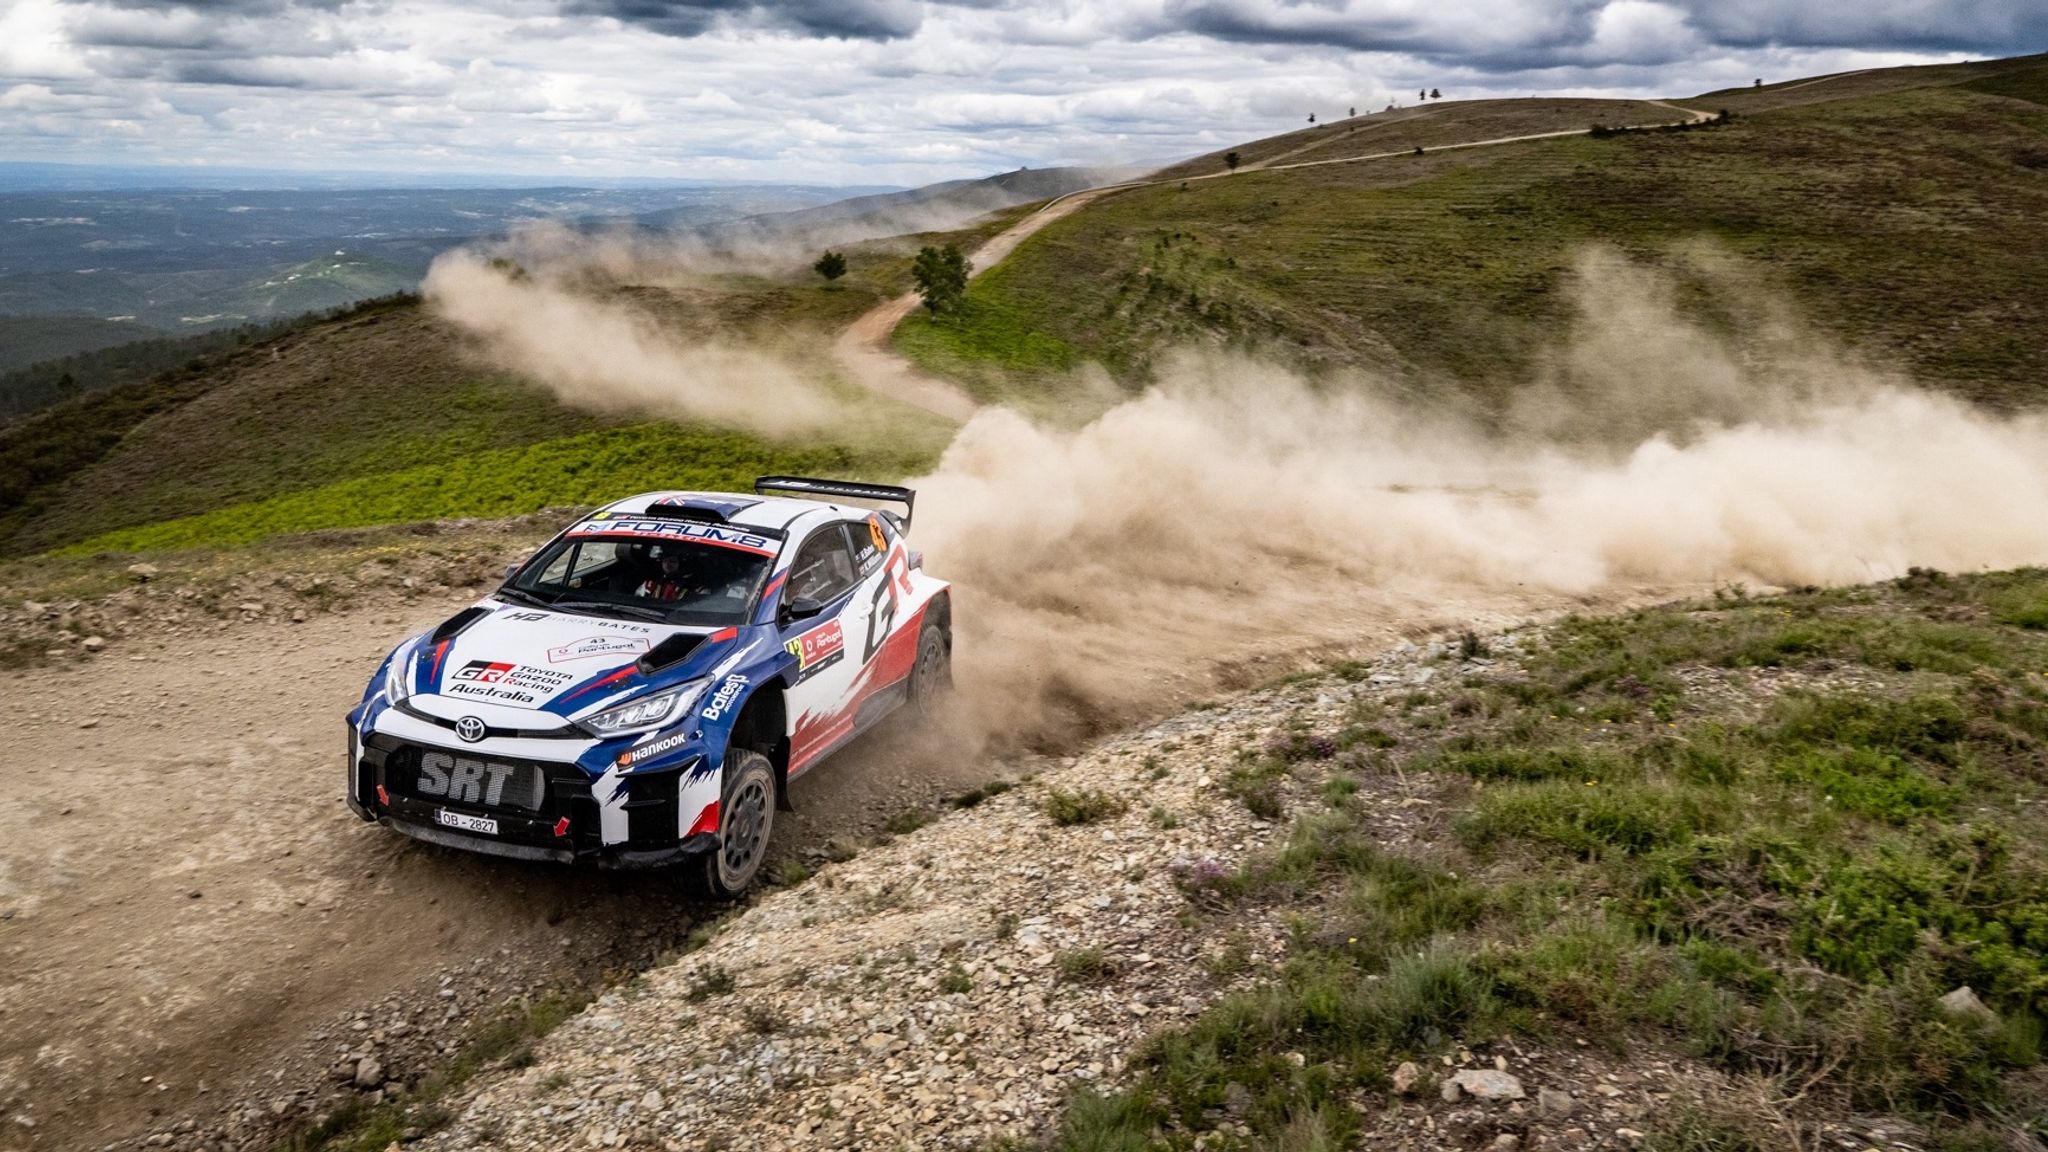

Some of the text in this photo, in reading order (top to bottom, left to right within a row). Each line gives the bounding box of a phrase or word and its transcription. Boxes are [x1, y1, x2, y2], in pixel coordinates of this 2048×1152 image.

[610, 521, 768, 549] FORUM8
[868, 513, 888, 553] 43
[862, 543, 915, 665] GR
[816, 628, 842, 649] Portugal
[451, 667, 505, 683] GR
[510, 671, 563, 686] GAZOO
[519, 665, 573, 680] TOYOTA
[449, 683, 535, 703] Australia
[502, 677, 555, 694] Racing
[701, 678, 740, 721] Bates
[417, 752, 515, 806] SRT
[443, 813, 459, 826] OB
[469, 818, 495, 832] 2827
